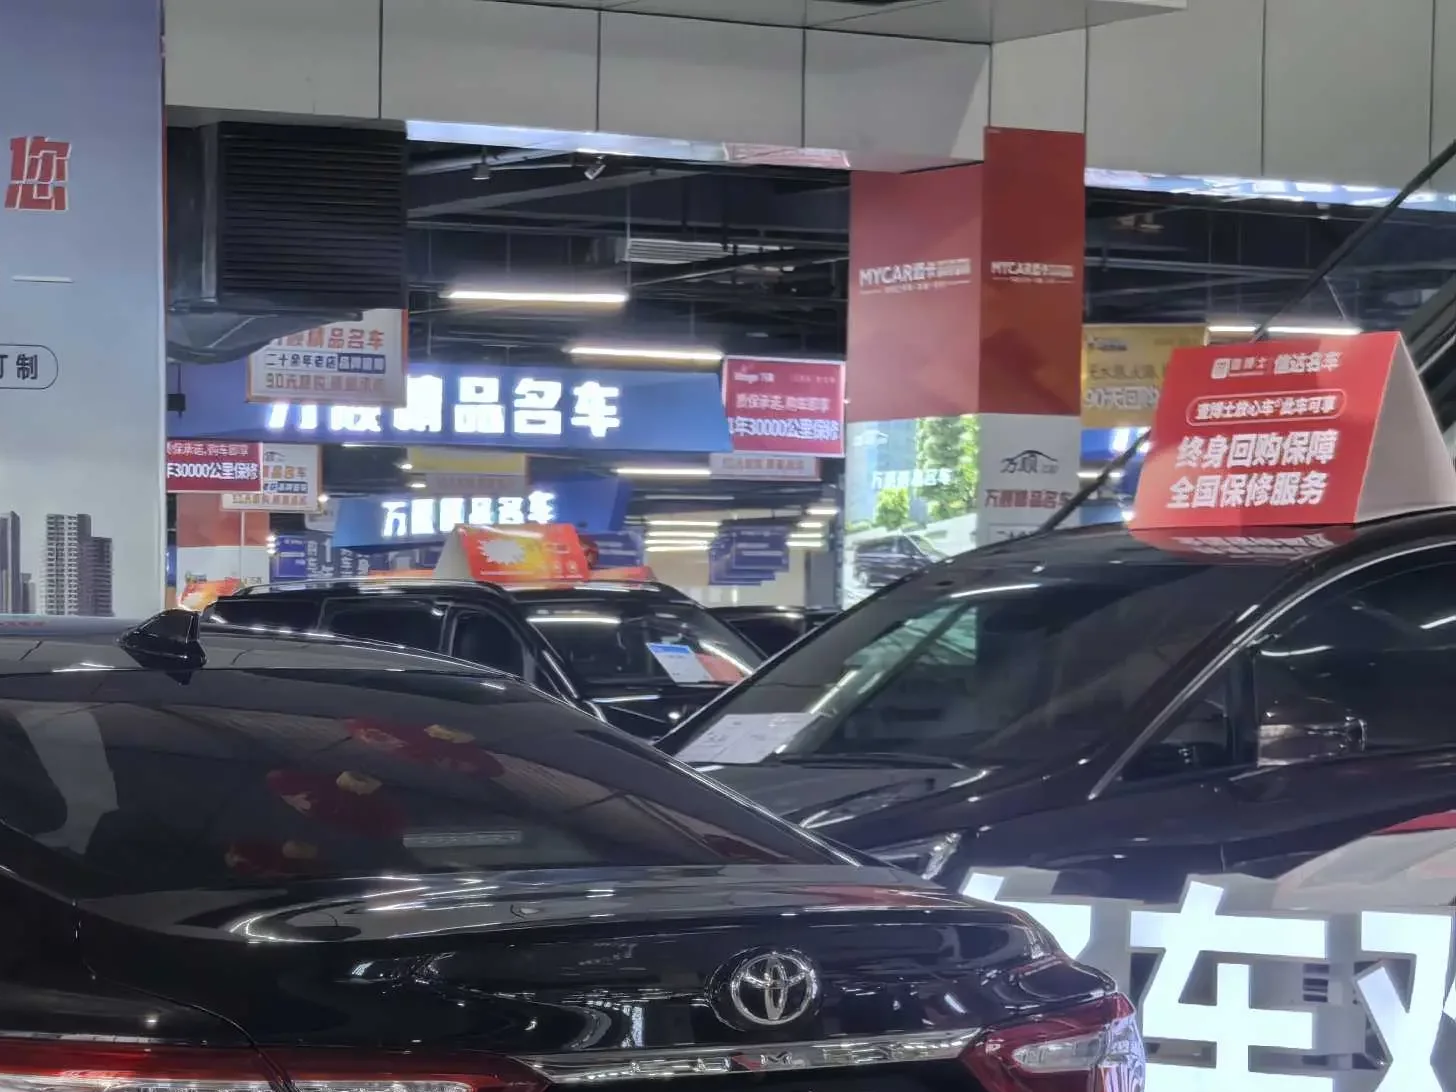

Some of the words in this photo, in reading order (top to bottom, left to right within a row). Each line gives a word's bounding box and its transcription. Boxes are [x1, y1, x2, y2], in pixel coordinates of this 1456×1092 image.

[1175, 429, 1340, 470] 终身回购保障
[1166, 470, 1329, 509] 全国保修服务
